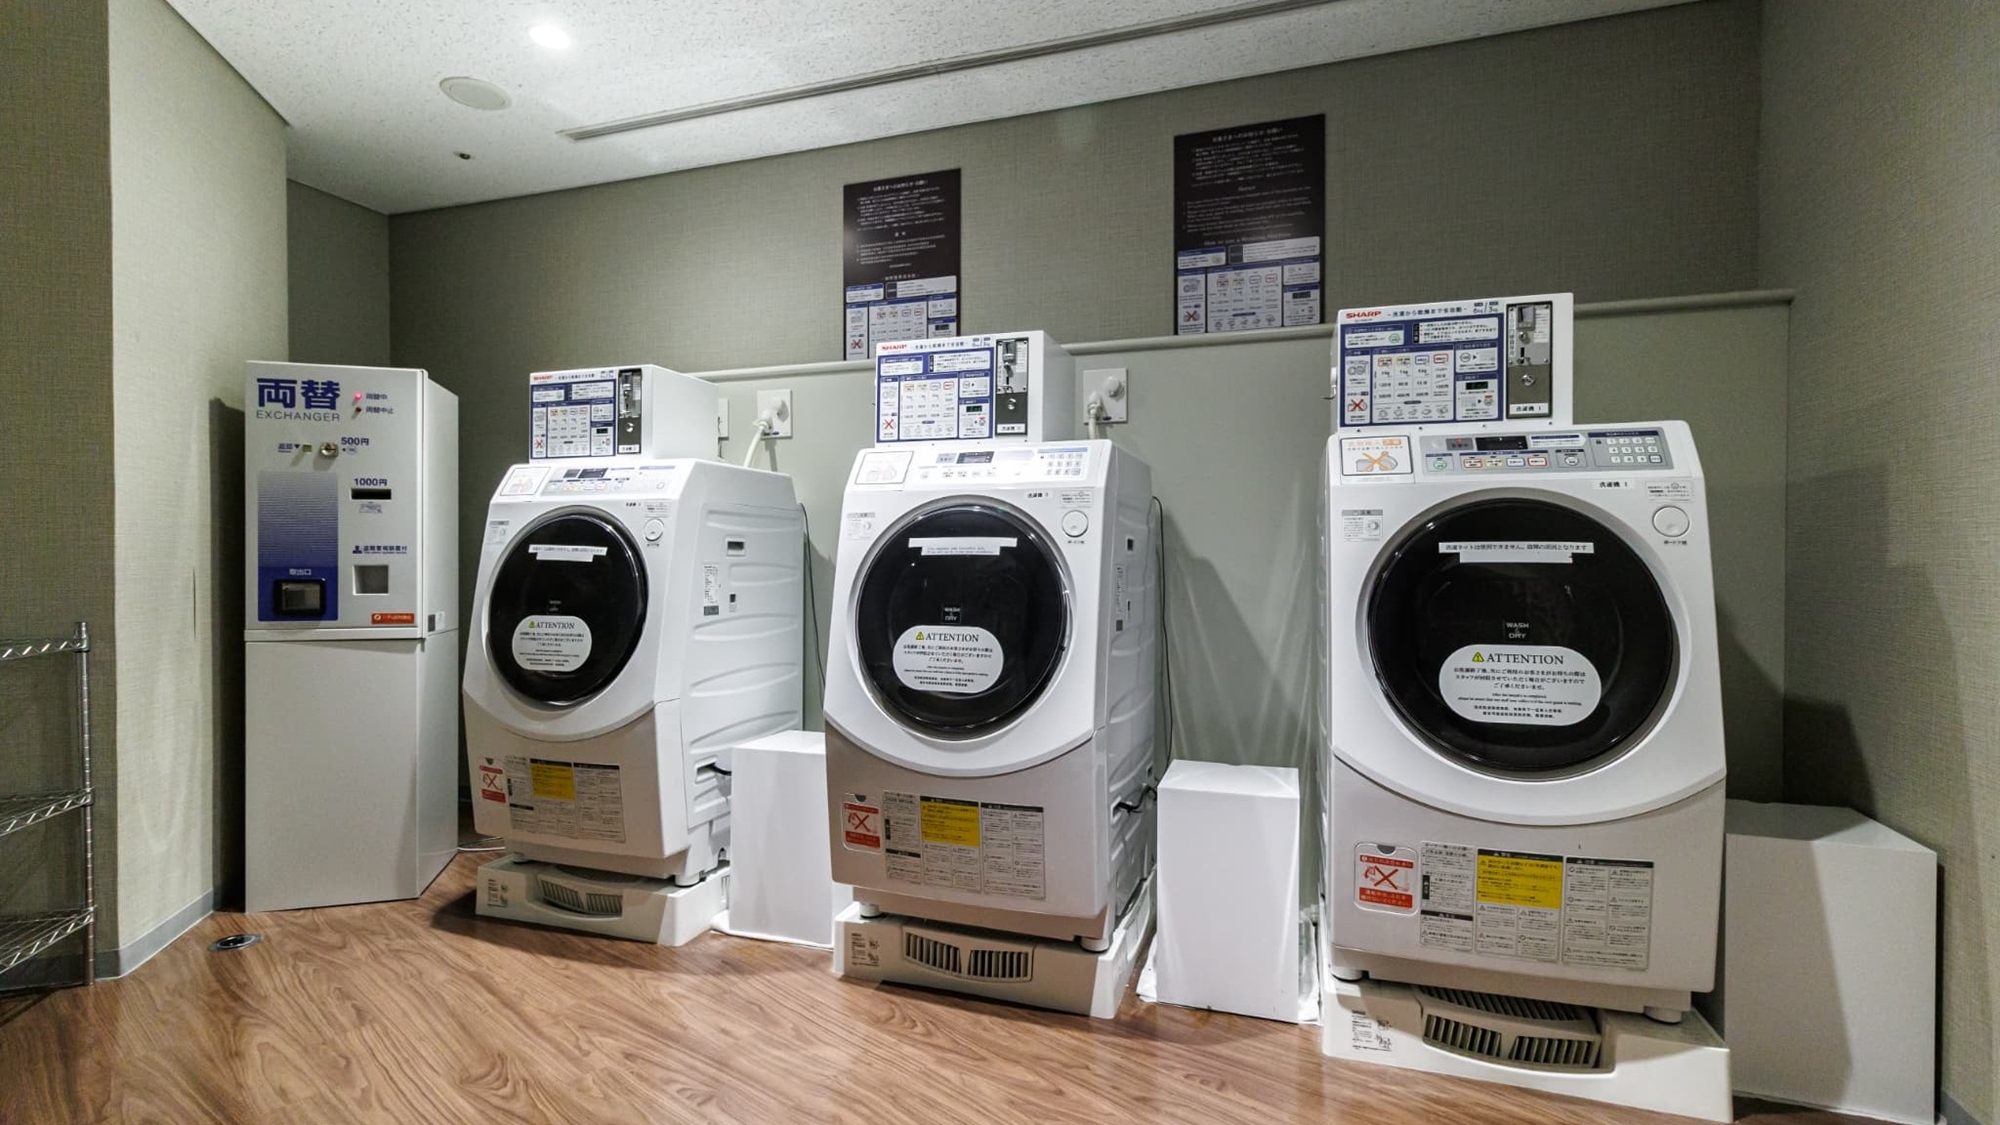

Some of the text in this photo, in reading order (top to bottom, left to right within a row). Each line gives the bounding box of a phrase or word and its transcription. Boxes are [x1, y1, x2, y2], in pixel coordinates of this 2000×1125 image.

[1345, 310, 1382, 319] SHARP
[256, 377, 341, 411] 両替
[366, 407, 394, 415] 両替中止
[256, 410, 341, 423] EXCHANGER
[340, 437, 370, 447] 500円
[353, 478, 388, 487] 1000円
[536, 621, 575, 629] ATTENTION
[925, 632, 980, 643] ATTENTION
[1486, 653, 1564, 665] ATTENTION
